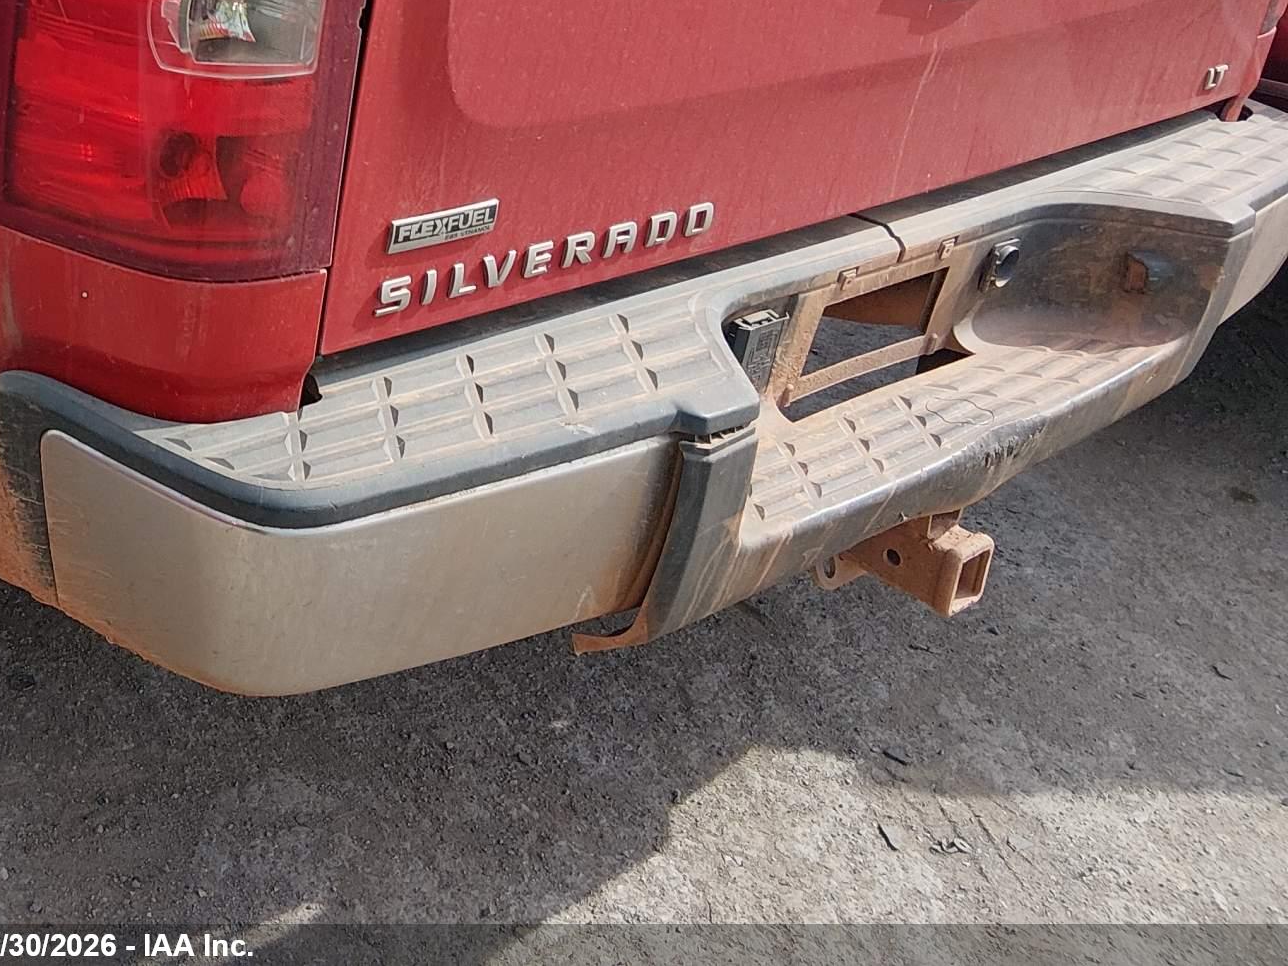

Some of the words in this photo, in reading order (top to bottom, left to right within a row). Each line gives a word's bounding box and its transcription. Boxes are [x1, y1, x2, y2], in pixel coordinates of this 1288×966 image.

[1205, 64, 1229, 90] LT
[397, 208, 494, 243] FLEXFUEL
[374, 201, 714, 317] SILVERADO
